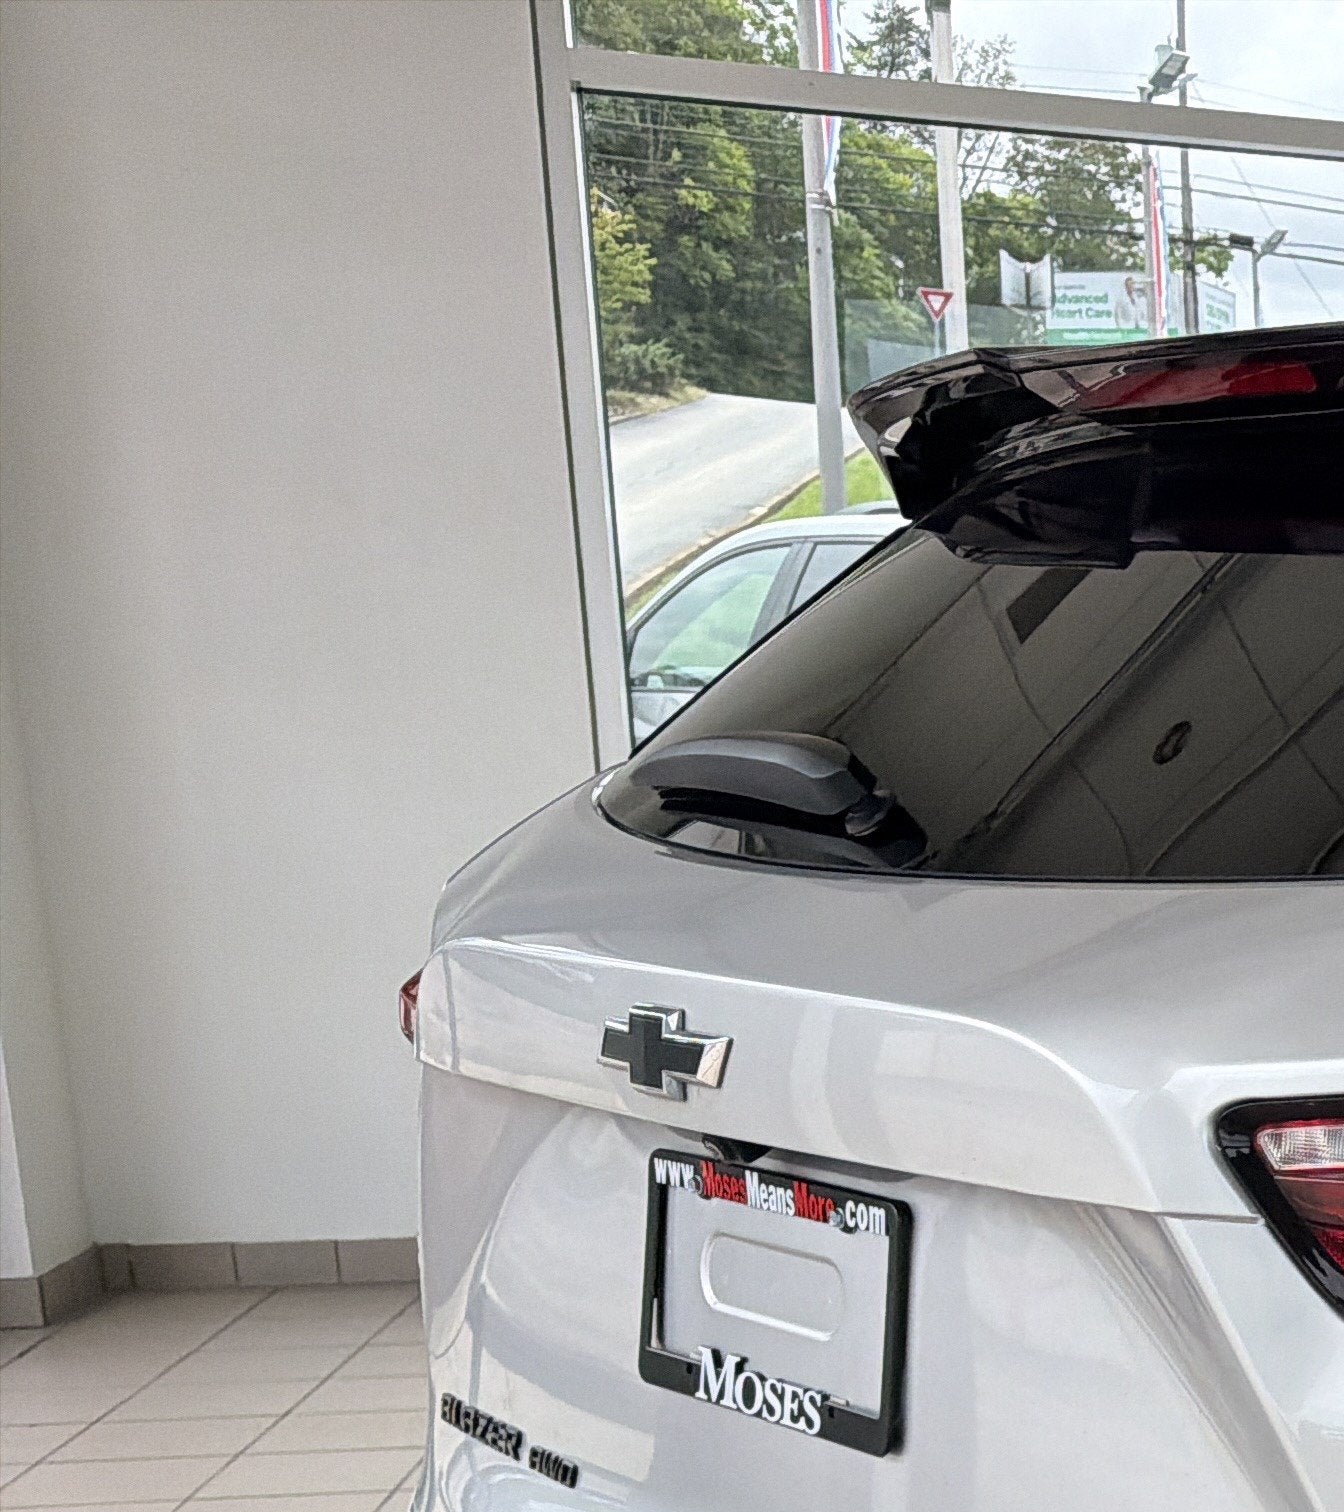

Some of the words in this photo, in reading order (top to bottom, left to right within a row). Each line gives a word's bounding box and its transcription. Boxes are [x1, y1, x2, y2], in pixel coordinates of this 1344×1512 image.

[653, 1157, 886, 1236] wwwMosesMeansMorecom
[441, 1392, 523, 1462] BLAZER
[528, 1445, 579, 1489] AWD
